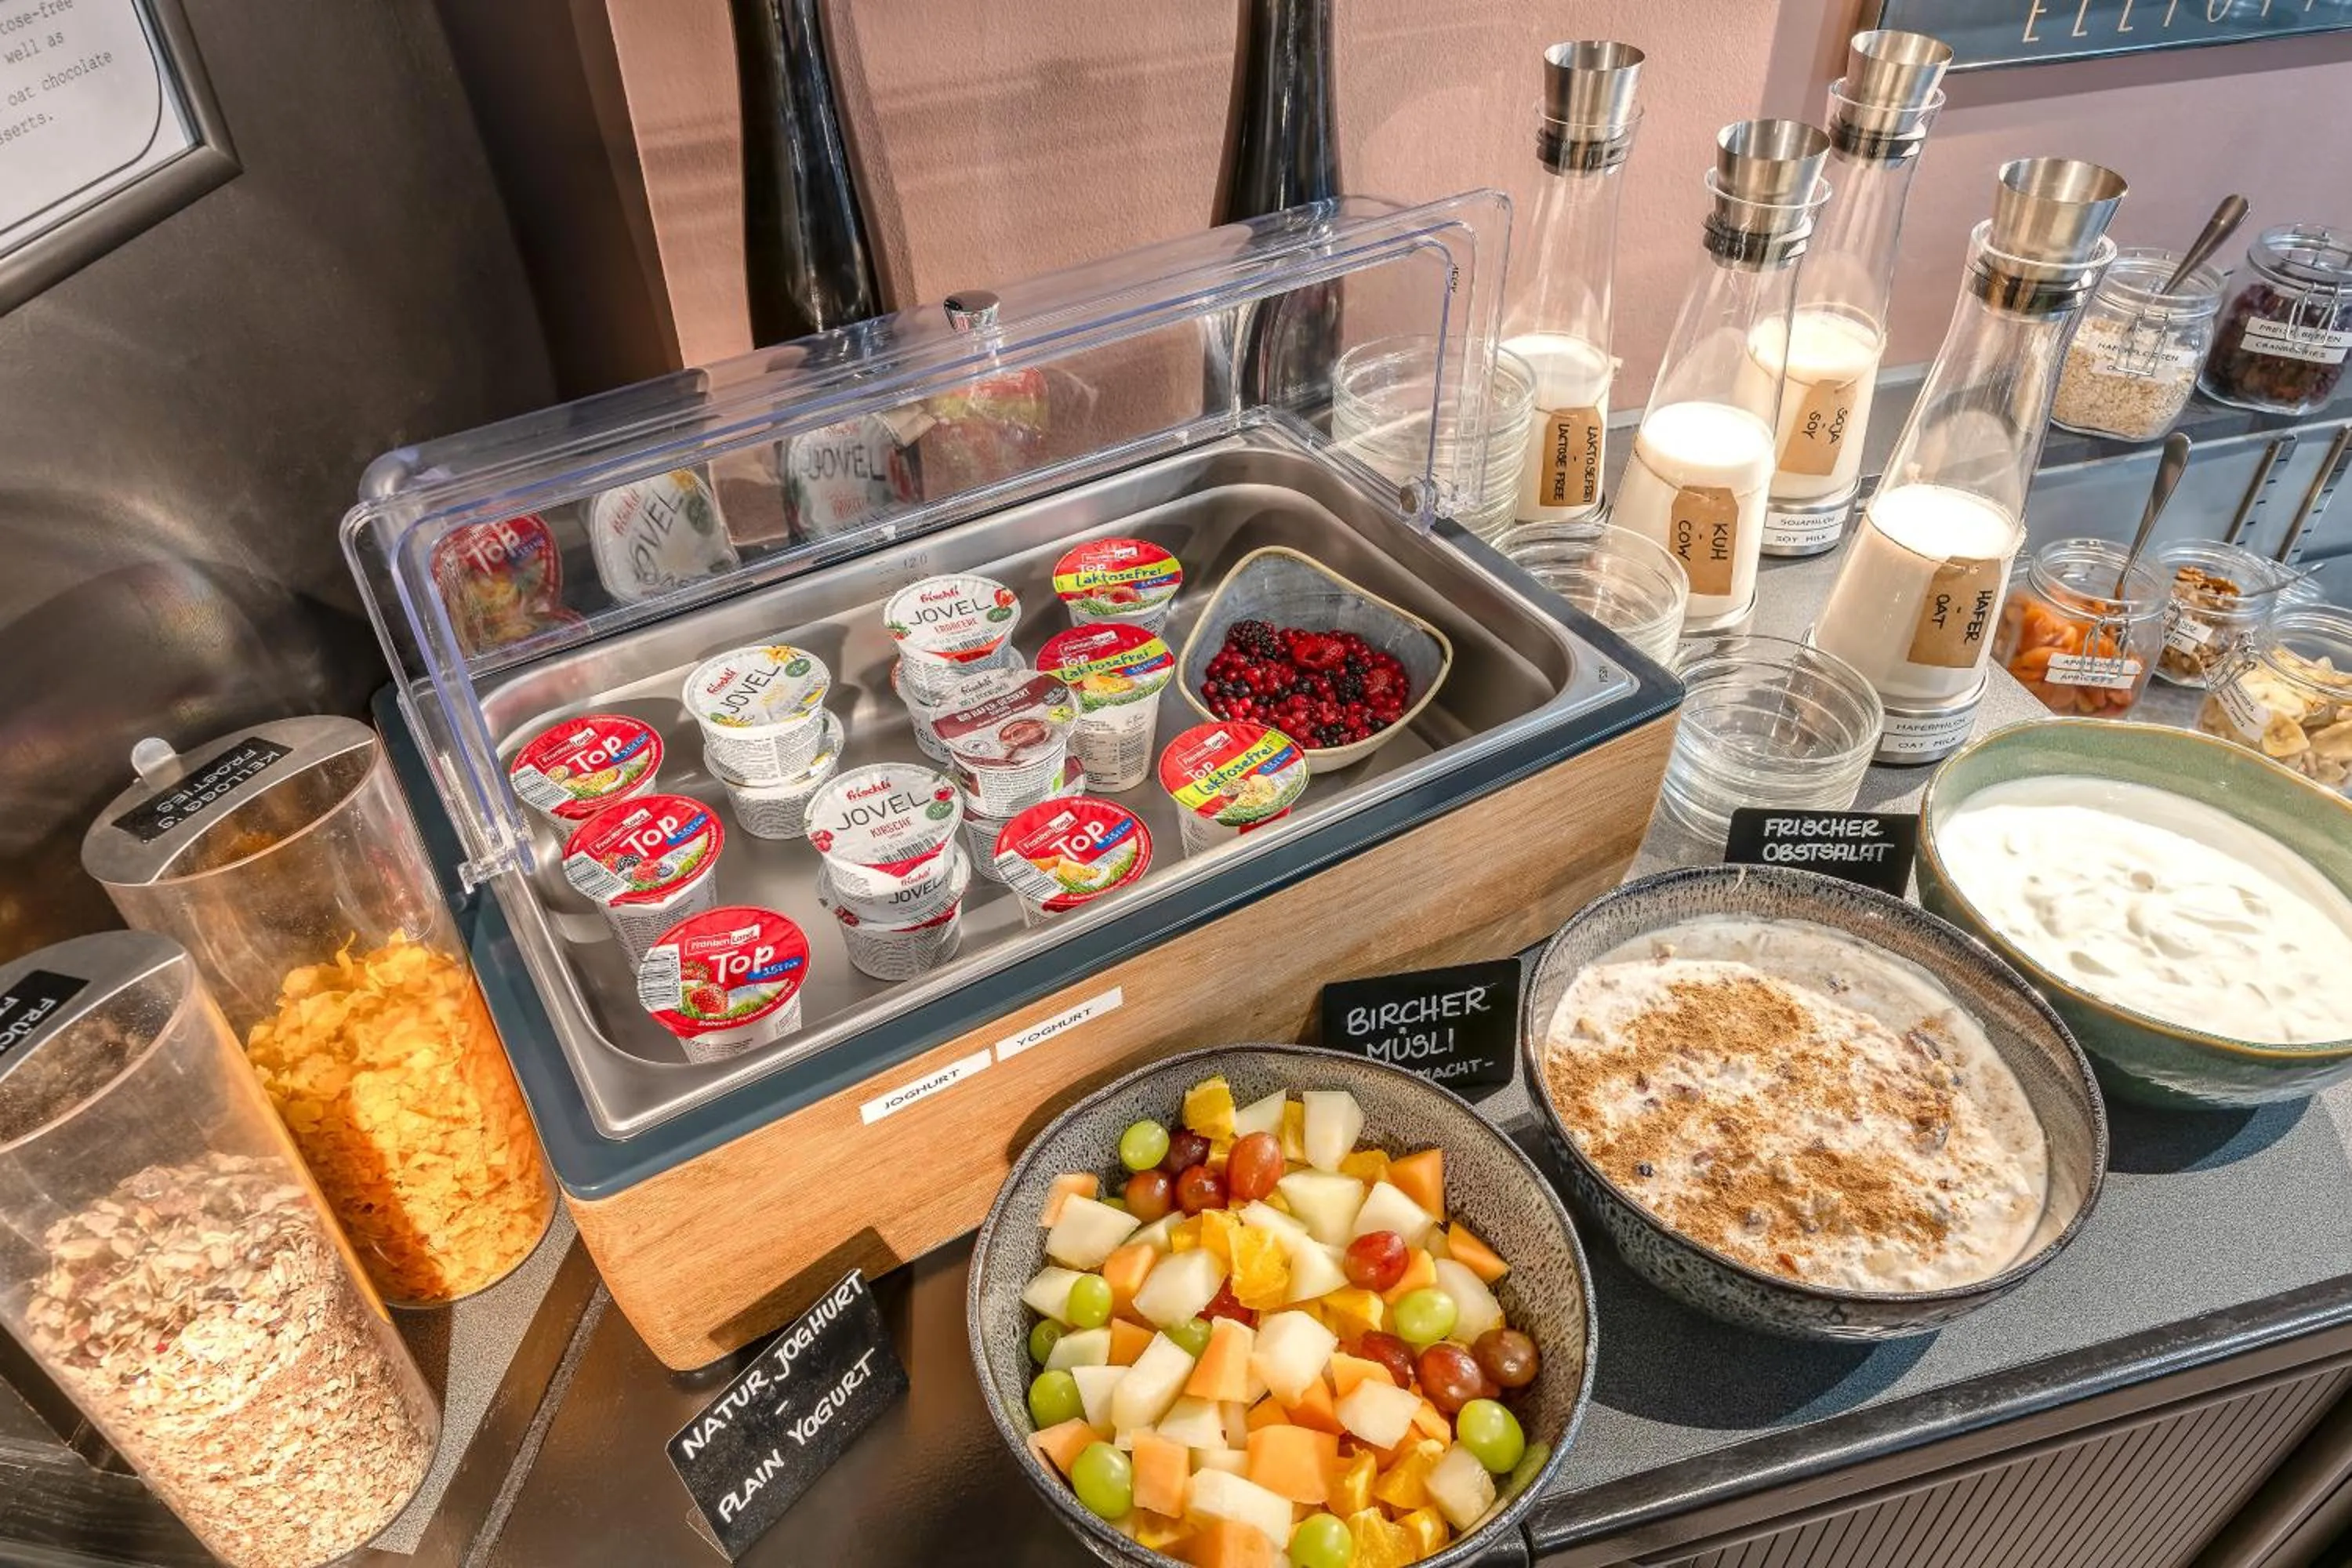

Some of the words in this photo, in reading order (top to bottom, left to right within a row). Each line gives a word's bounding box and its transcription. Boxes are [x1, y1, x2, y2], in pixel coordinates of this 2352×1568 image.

[3, 39, 40, 64] well
[48, 31, 64, 47] as
[8, 87, 36, 106] oat
[42, 51, 113, 91] chocolate
[1802, 411, 1821, 440] SOY
[1553, 472, 1566, 502] FREE
[1677, 520, 1692, 562] COW
[1710, 523, 1729, 561] KUH
[909, 598, 993, 626] JOVEL
[1932, 593, 1950, 630] OAT
[1964, 590, 1994, 645] HAFER
[719, 666, 782, 714] JOVEL
[566, 735, 622, 772] Top
[1192, 745, 1274, 796] Laktosefrei
[156, 748, 256, 814] FROSTIES
[836, 790, 931, 832] JOVEL
[1763, 818, 1884, 838] FRISCHER
[619, 815, 679, 858] Top
[1048, 820, 1105, 862] Top
[1762, 843, 1896, 862] OBSTSALAT
[888, 876, 949, 905] JOVEL
[708, 945, 775, 985] Top
[1016, 1007, 1093, 1047] YOGHURT
[1346, 985, 1491, 1036] BIRCHER
[1366, 1026, 1454, 1063] MÜSLI
[884, 1068, 961, 1110] JOGHURT
[681, 1368, 770, 1460] NATUR
[773, 1267, 863, 1382] JOGHURT
[717, 1447, 786, 1524] PLAIN
[786, 1346, 876, 1446] YOGURT
